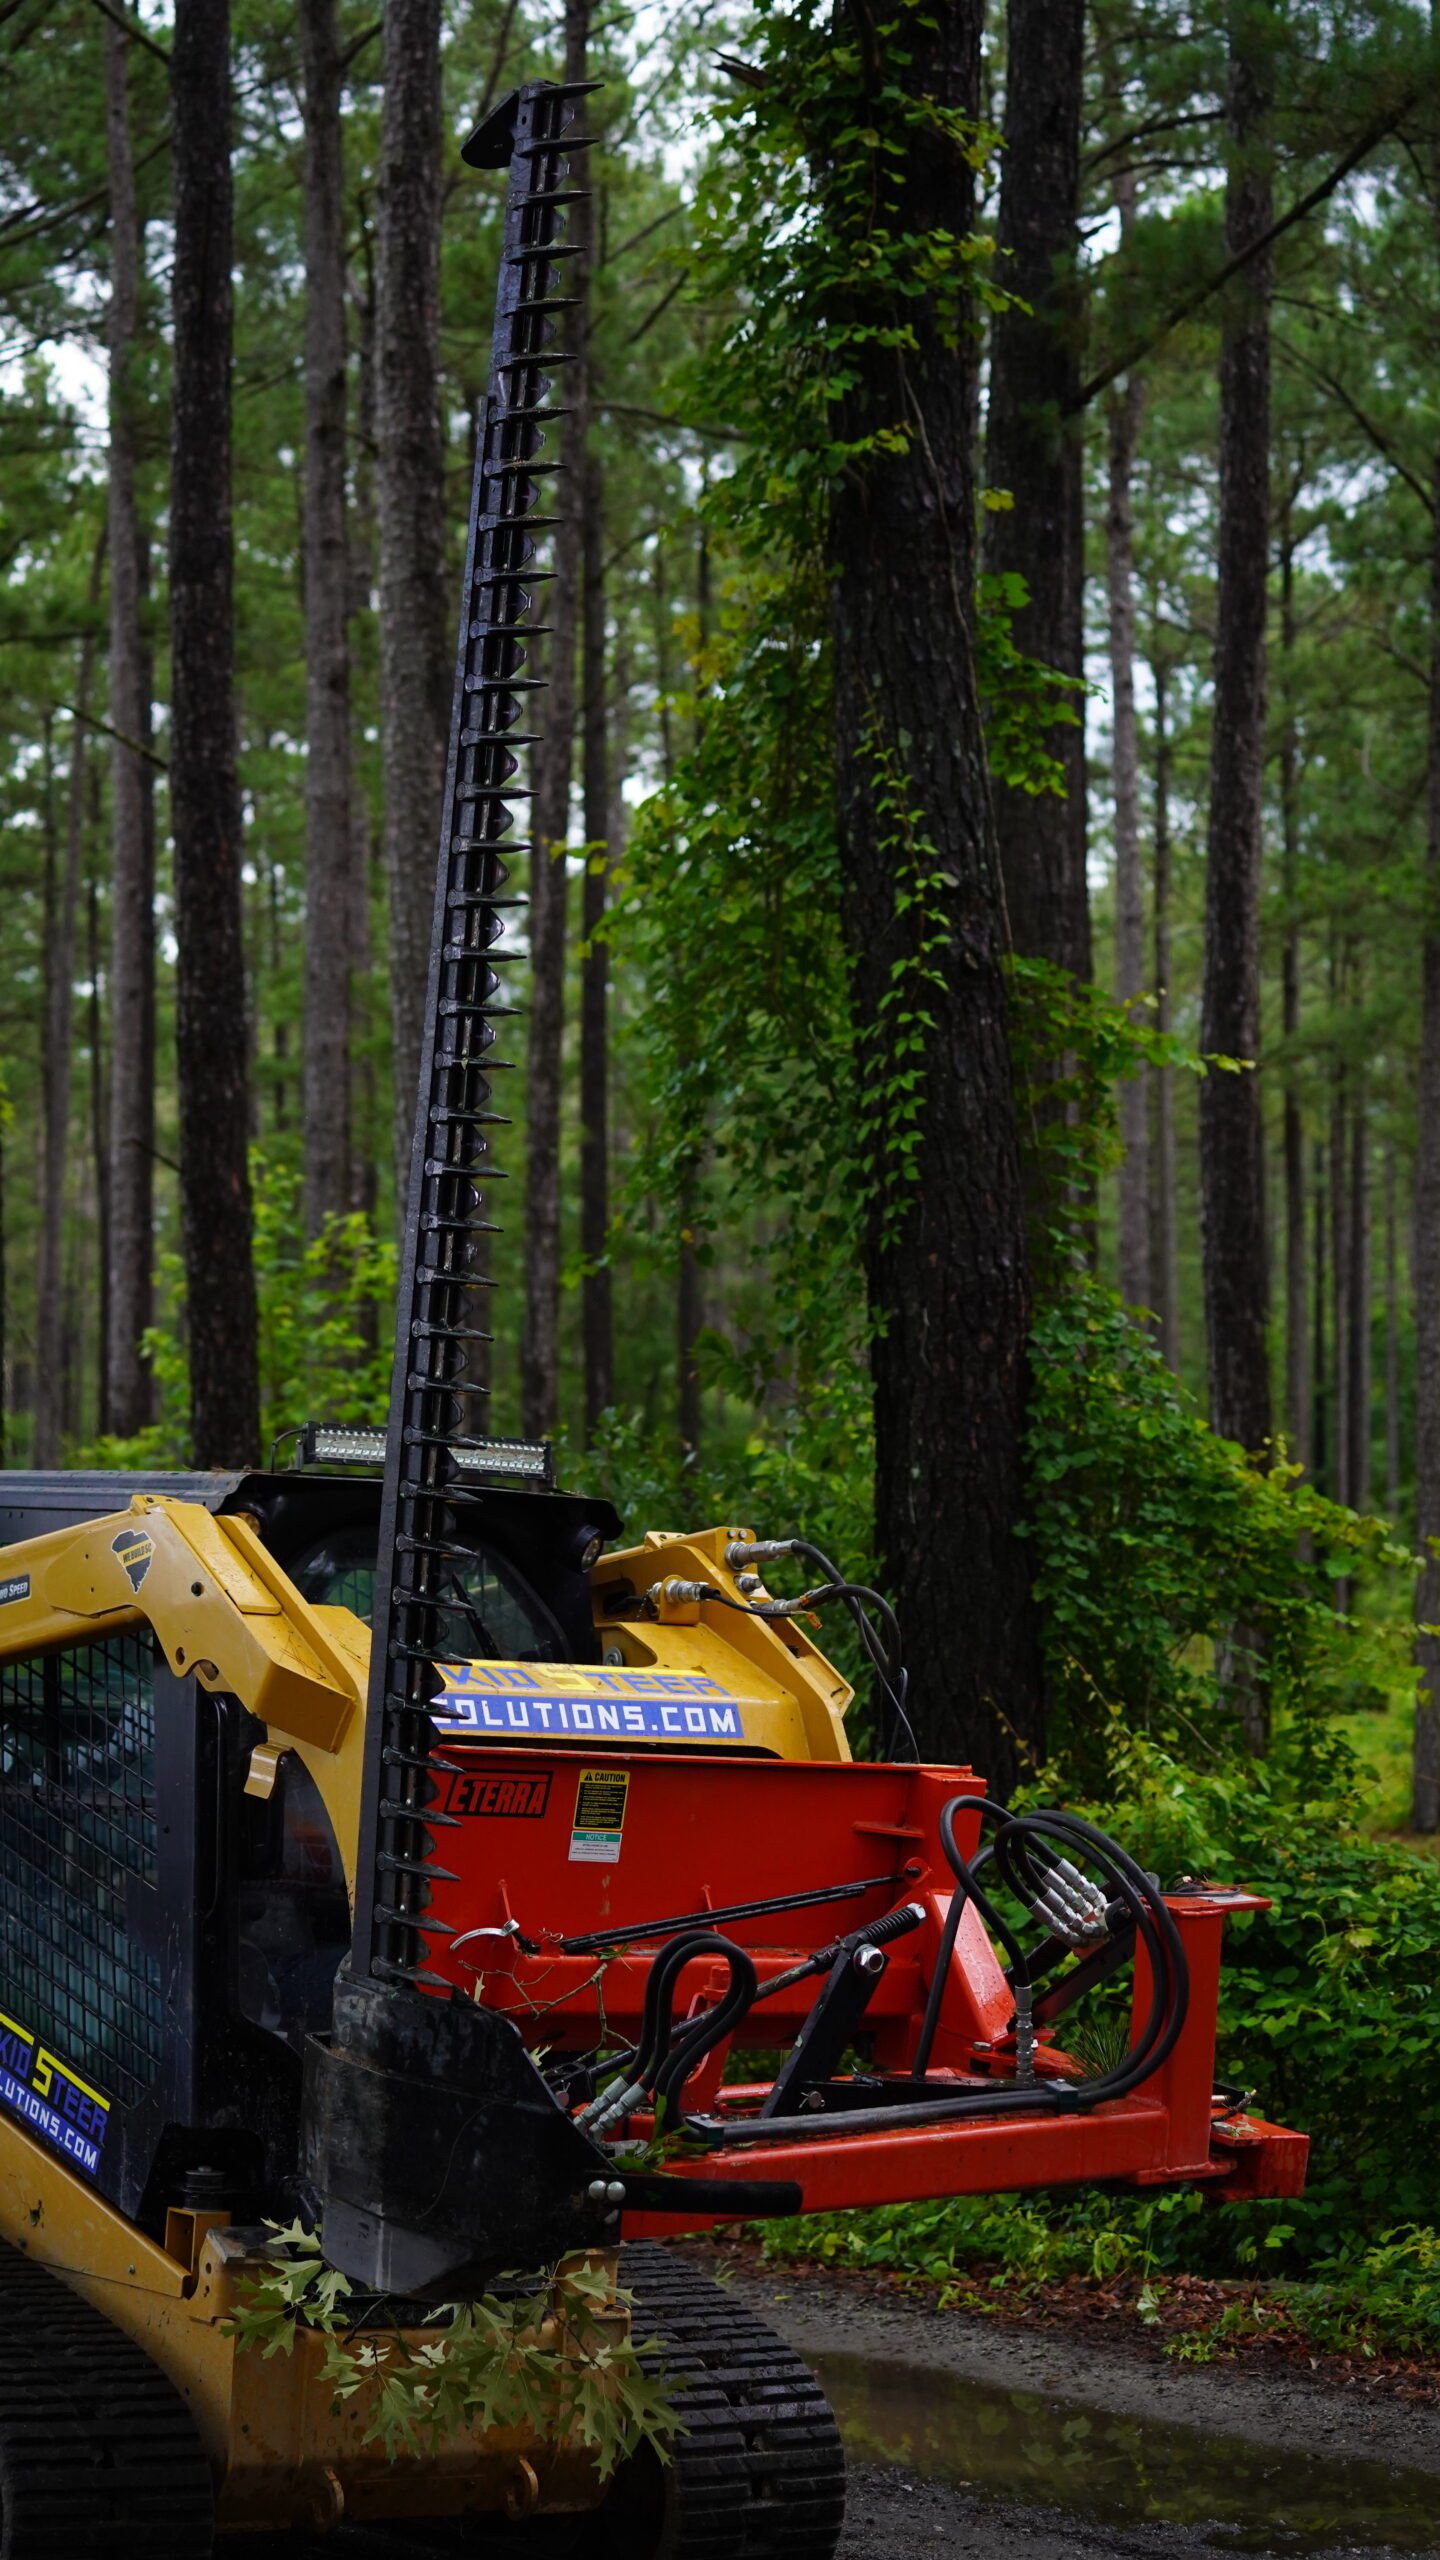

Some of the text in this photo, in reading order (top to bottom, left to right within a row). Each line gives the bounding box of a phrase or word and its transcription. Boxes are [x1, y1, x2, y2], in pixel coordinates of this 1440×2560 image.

[433, 1660, 731, 1696] KID STEER
[594, 1772, 626, 1783] CAUTION
[585, 1833, 608, 1842] NOTICE
[32, 2046, 110, 2144] STEER
